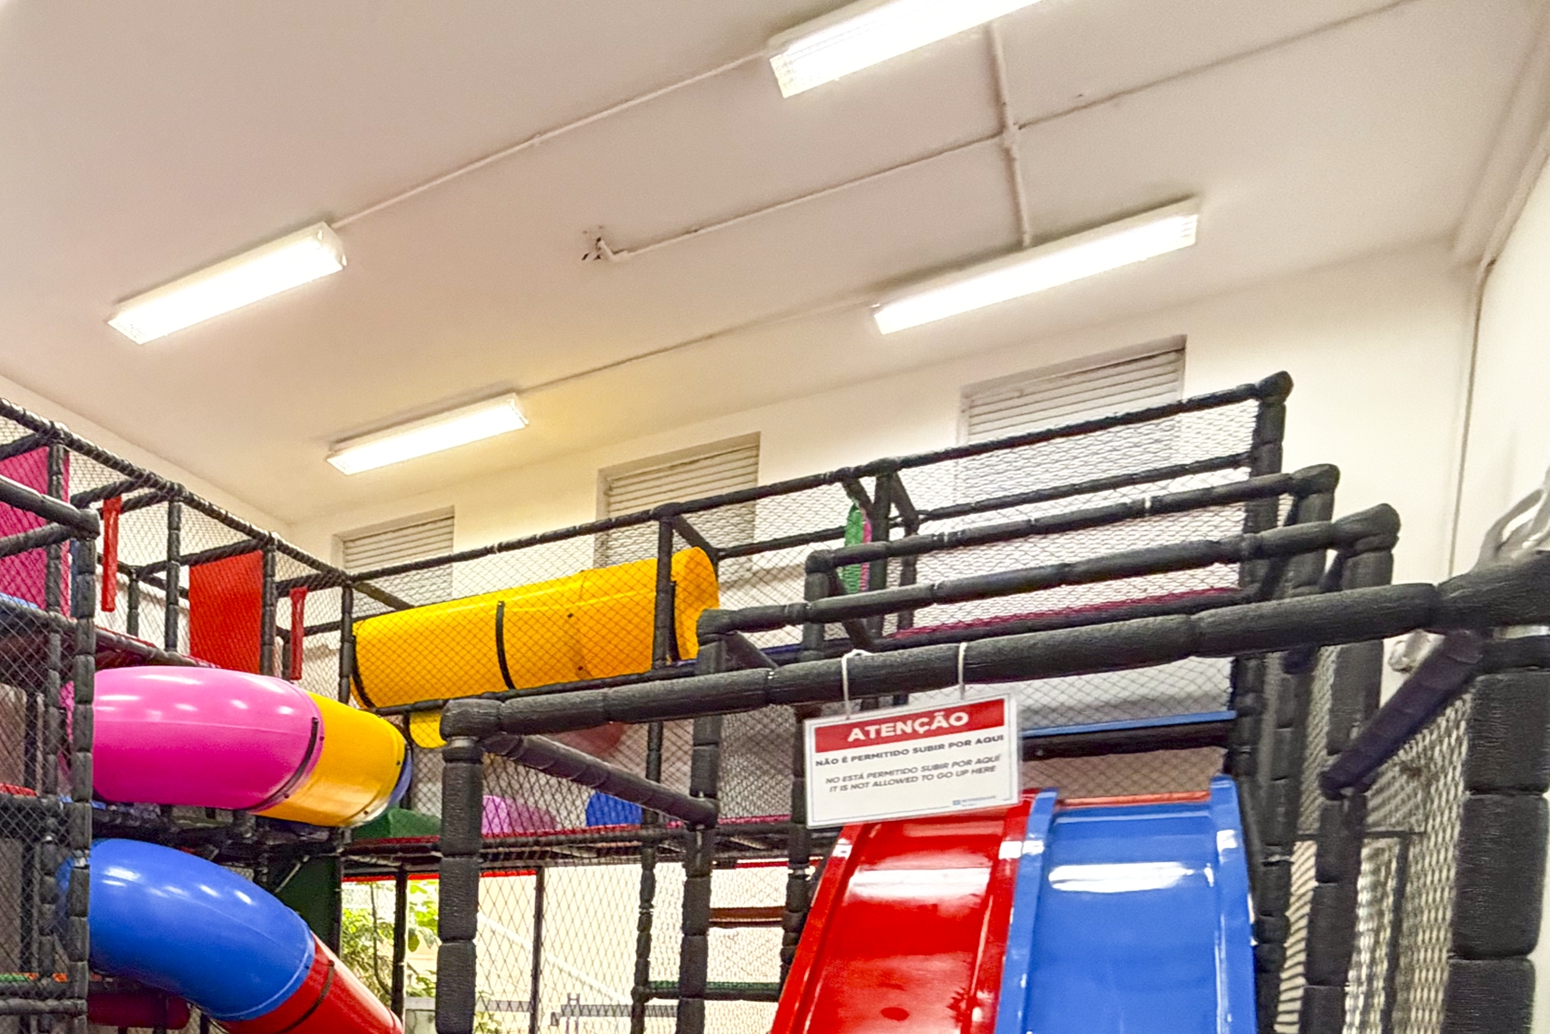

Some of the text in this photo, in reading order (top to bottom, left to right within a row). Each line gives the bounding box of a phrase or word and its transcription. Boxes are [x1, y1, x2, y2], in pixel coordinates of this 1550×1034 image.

[847, 711, 969, 742] ATENÇÃO
[815, 757, 839, 767] NÃO
[841, 755, 848, 763] É
[850, 748, 910, 762] PERMITIDO
[912, 743, 945, 754] SUBIR
[948, 739, 972, 749] POR
[825, 776, 841, 784] NO
[842, 772, 865, 783] ESTÁ
[866, 766, 918, 779] PERMITIDO
[920, 762, 950, 773] SUBIR
[951, 759, 973, 768] POR
[829, 765, 997, 793] IT IS NOT ALLOWED TO GO UP HERE
